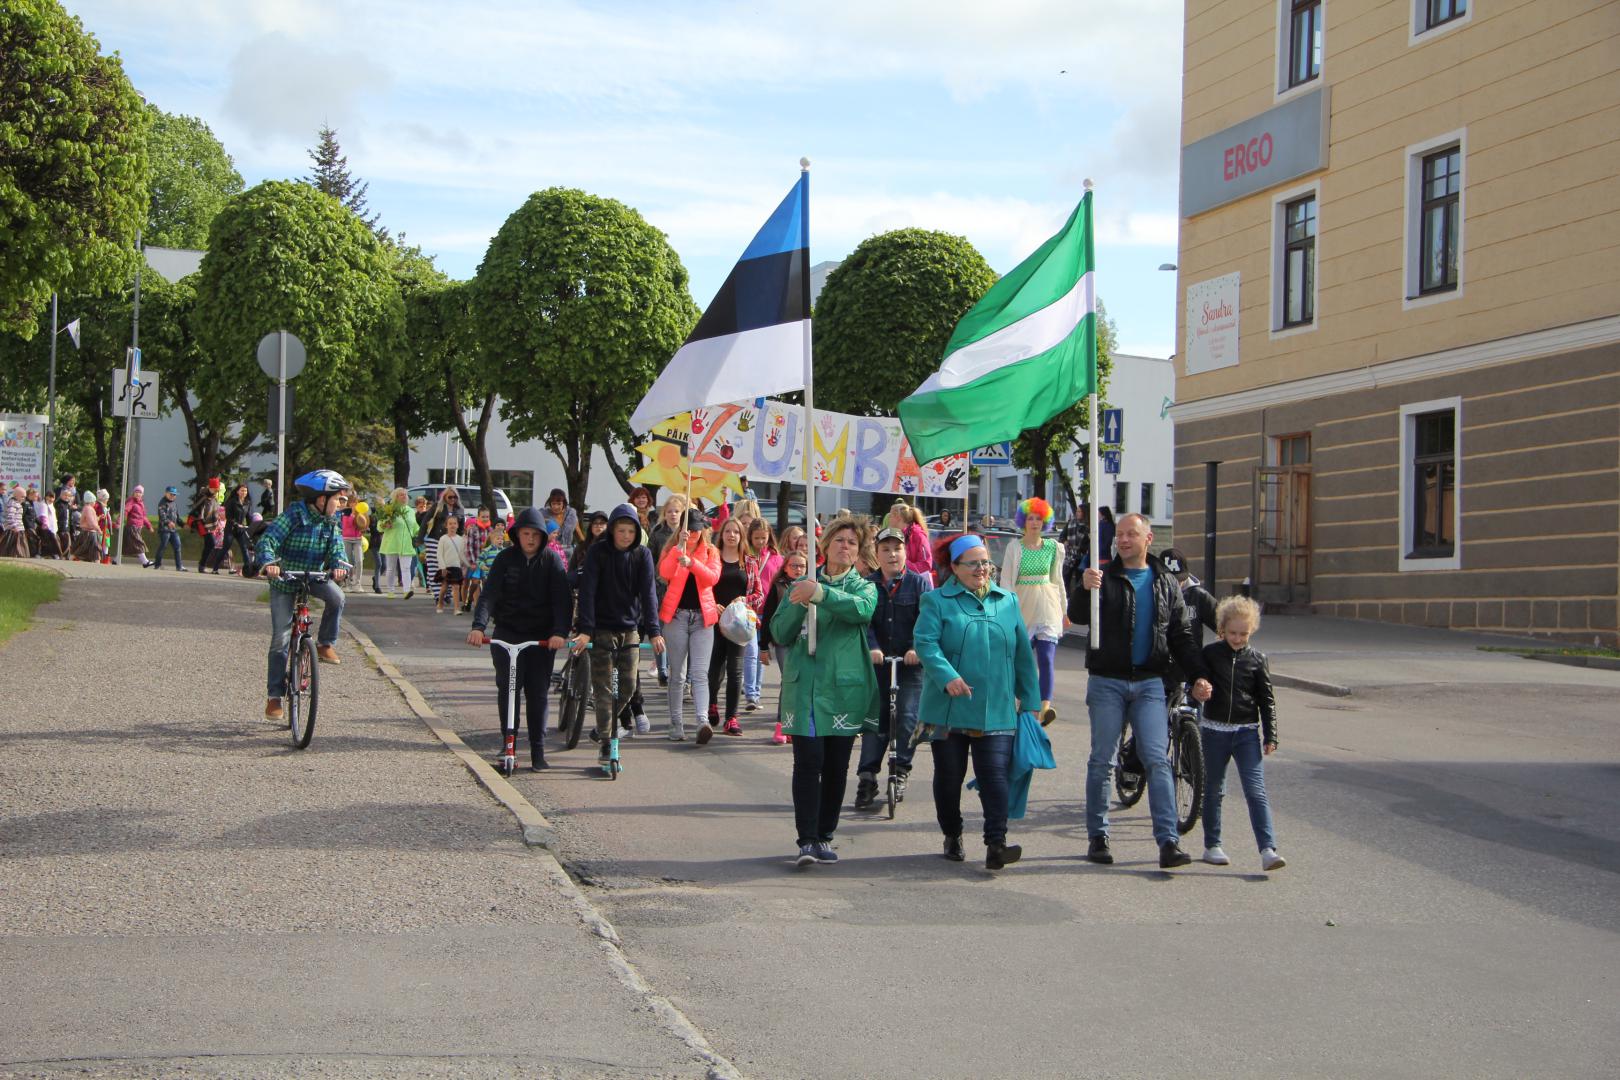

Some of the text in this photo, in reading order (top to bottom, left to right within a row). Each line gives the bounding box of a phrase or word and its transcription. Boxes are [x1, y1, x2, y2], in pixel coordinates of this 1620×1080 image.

[1224, 132, 1273, 182] ERGO
[1201, 299, 1232, 326] Sandra
[692, 402, 925, 493] ZUMBA
